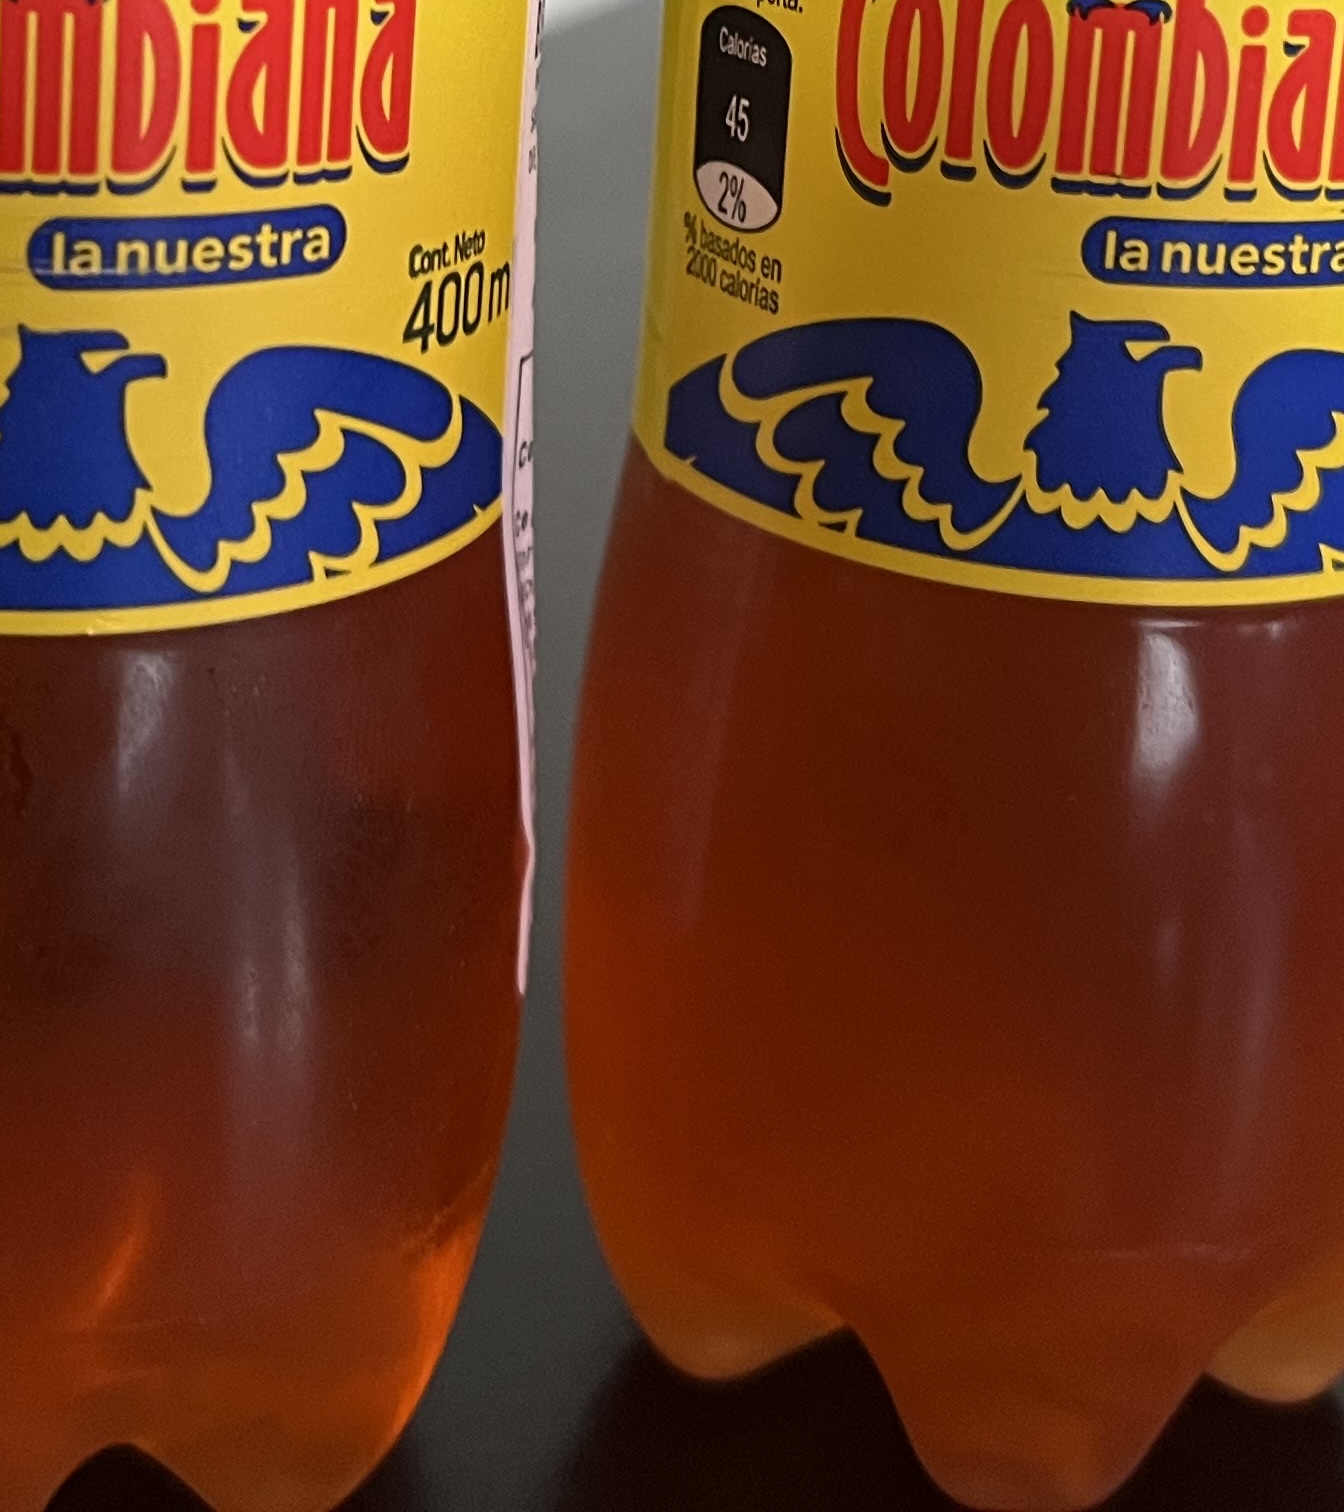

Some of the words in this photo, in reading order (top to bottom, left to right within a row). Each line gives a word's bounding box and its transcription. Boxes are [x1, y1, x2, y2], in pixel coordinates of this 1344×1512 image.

[725, 94, 751, 142] 45
[717, 171, 747, 224] 2%
[52, 231, 103, 276] la
[115, 222, 332, 276] nuestra
[761, 253, 783, 284] en
[1103, 229, 1150, 273] la
